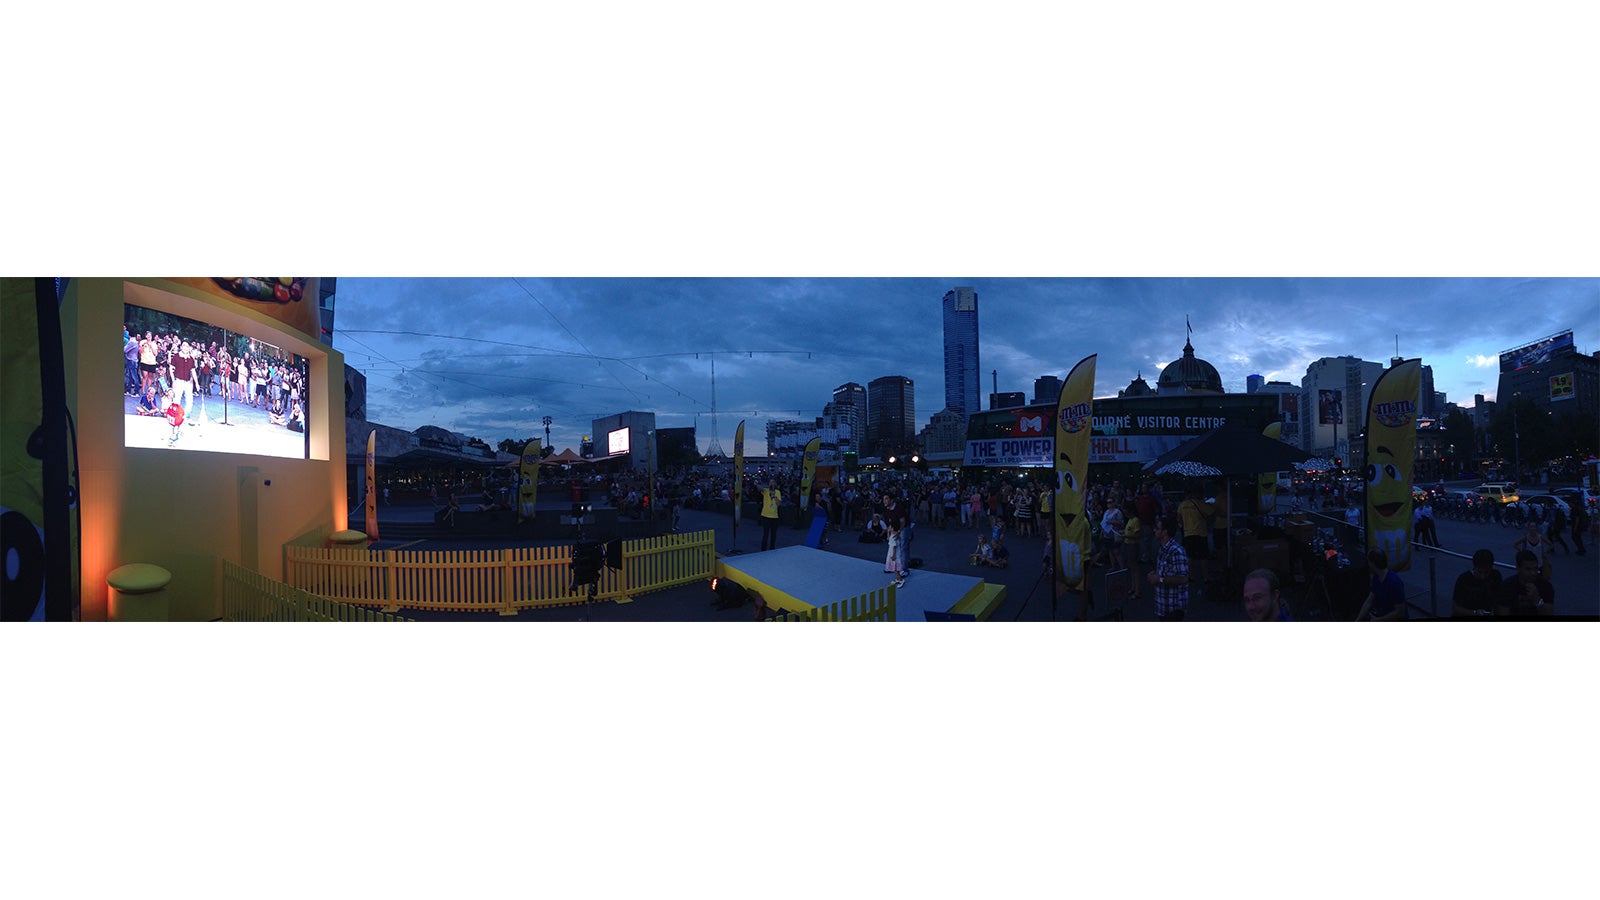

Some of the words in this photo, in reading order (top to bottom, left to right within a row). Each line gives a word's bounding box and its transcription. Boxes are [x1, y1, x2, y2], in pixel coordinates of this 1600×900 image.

[1137, 416, 1180, 428] VISITOR
[971, 442, 996, 457] THE
[1002, 440, 1051, 457] POWER
